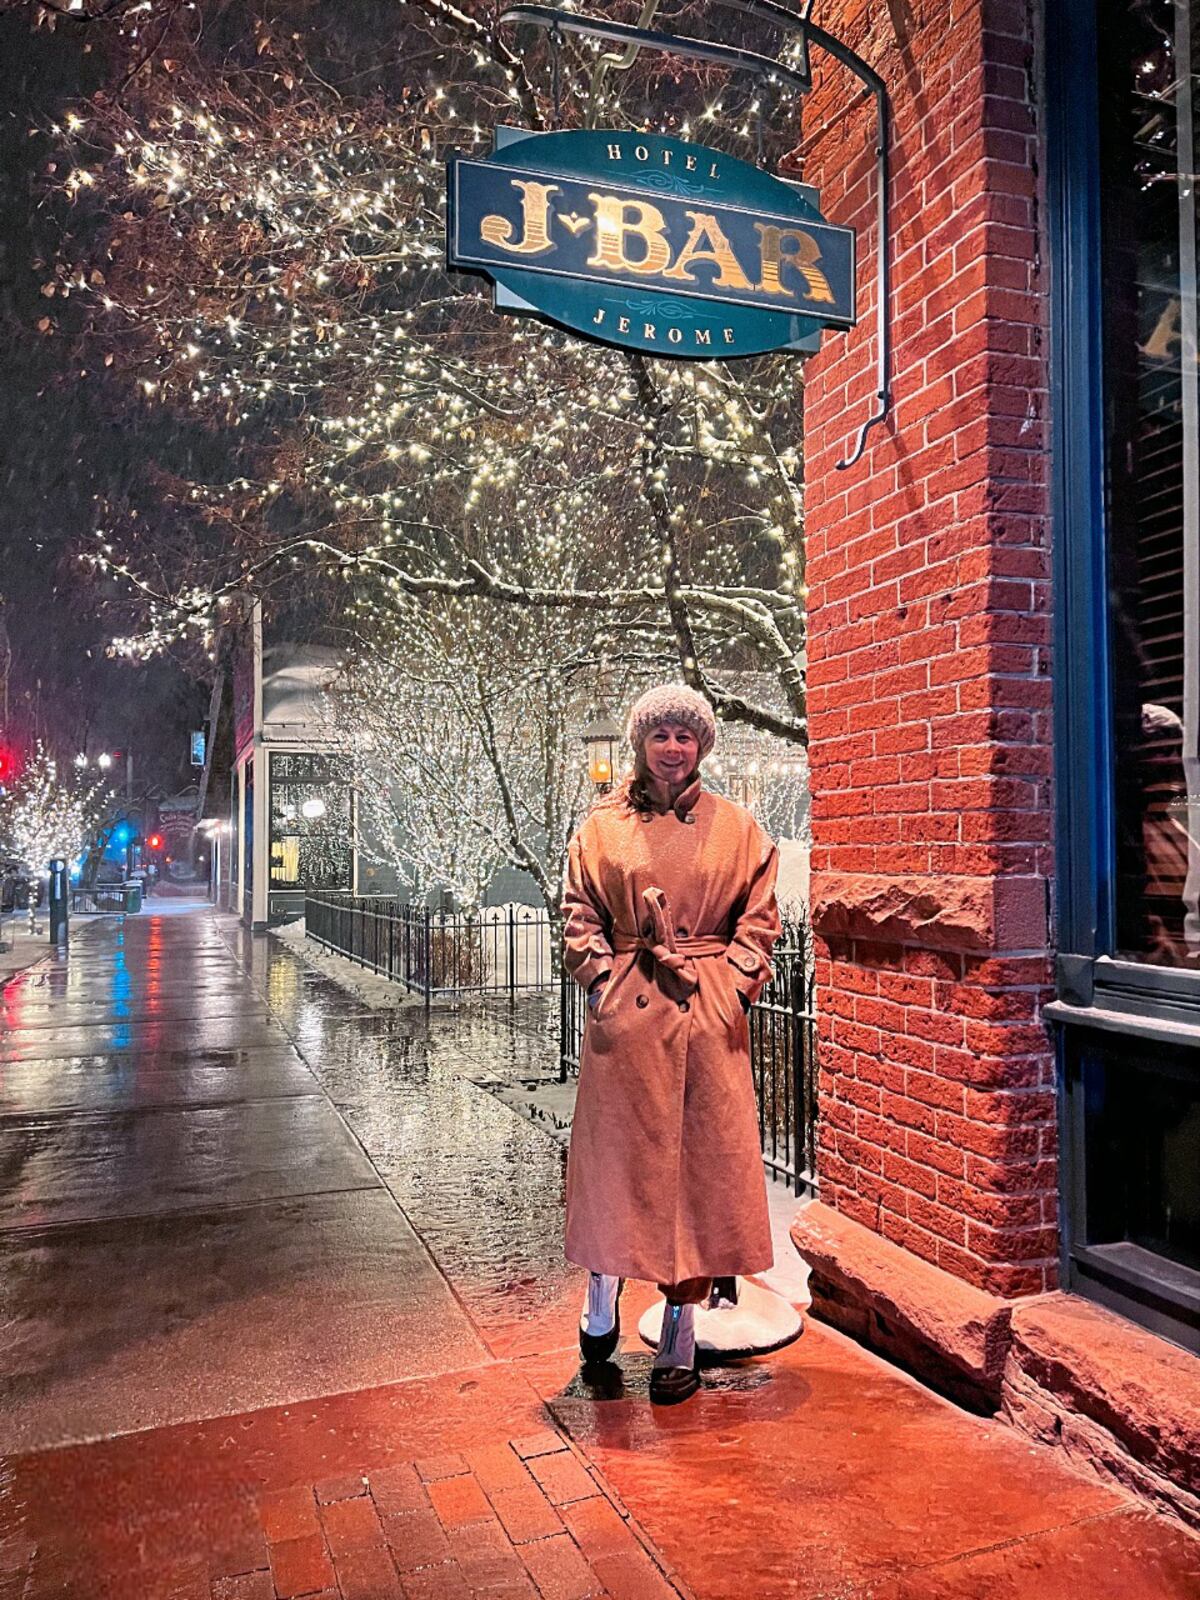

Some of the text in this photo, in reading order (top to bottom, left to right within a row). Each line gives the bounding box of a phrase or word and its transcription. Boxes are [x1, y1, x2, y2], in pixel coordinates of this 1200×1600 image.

[607, 144, 721, 179] HOTEL
[587, 193, 836, 303] BAR
[593, 310, 735, 345] JEROME
